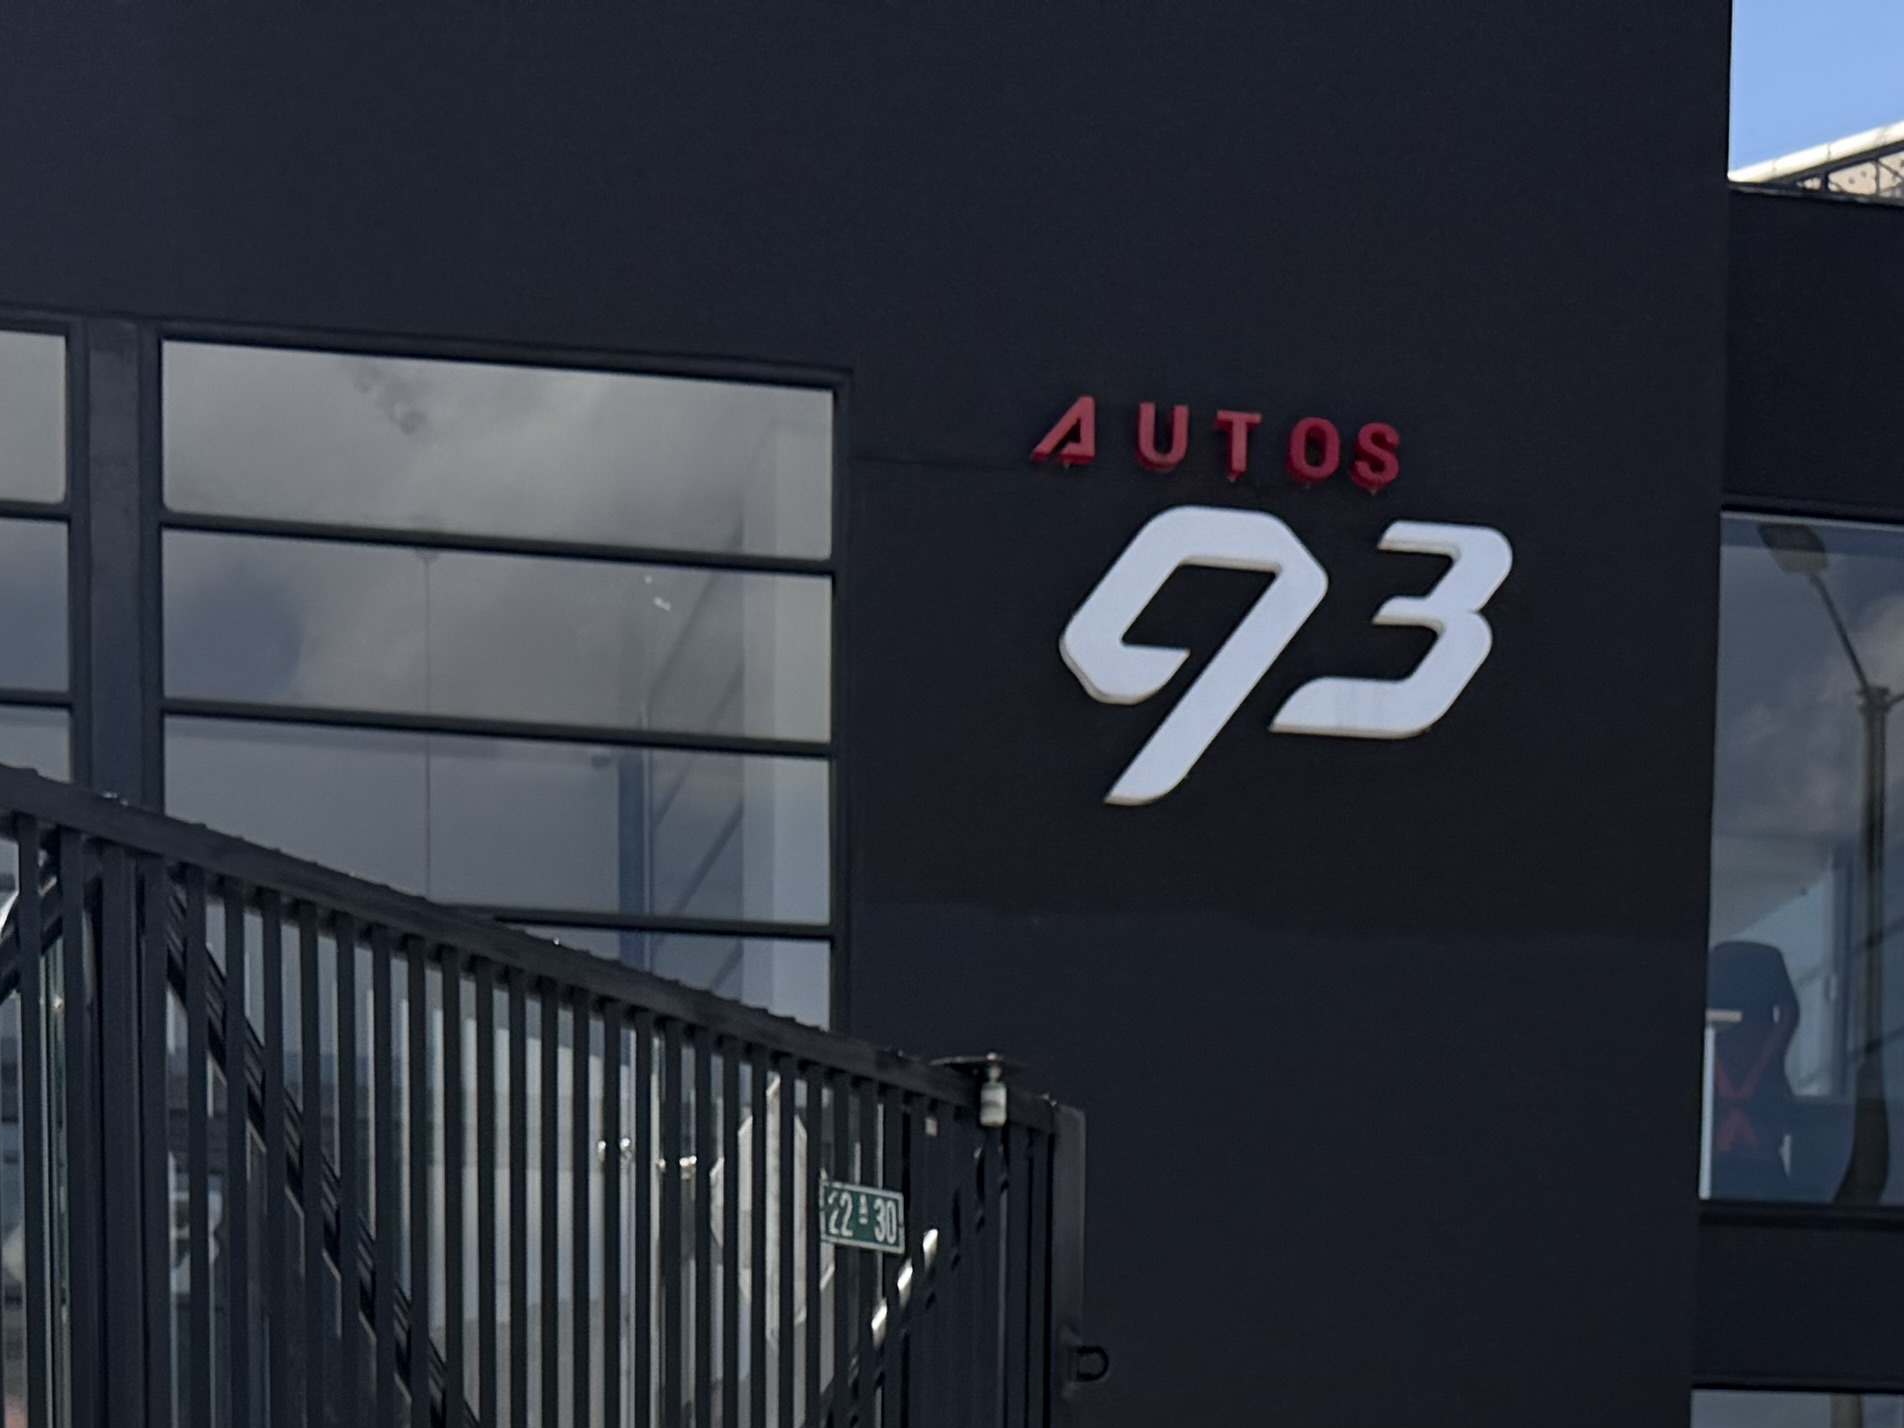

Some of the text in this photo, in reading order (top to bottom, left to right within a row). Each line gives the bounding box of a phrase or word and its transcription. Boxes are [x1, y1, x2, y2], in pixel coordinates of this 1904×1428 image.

[1030, 396, 1400, 490] AUTOS
[1058, 505, 1514, 806] 93
[827, 1190, 854, 1238] 22
[873, 1197, 898, 1245] 30
